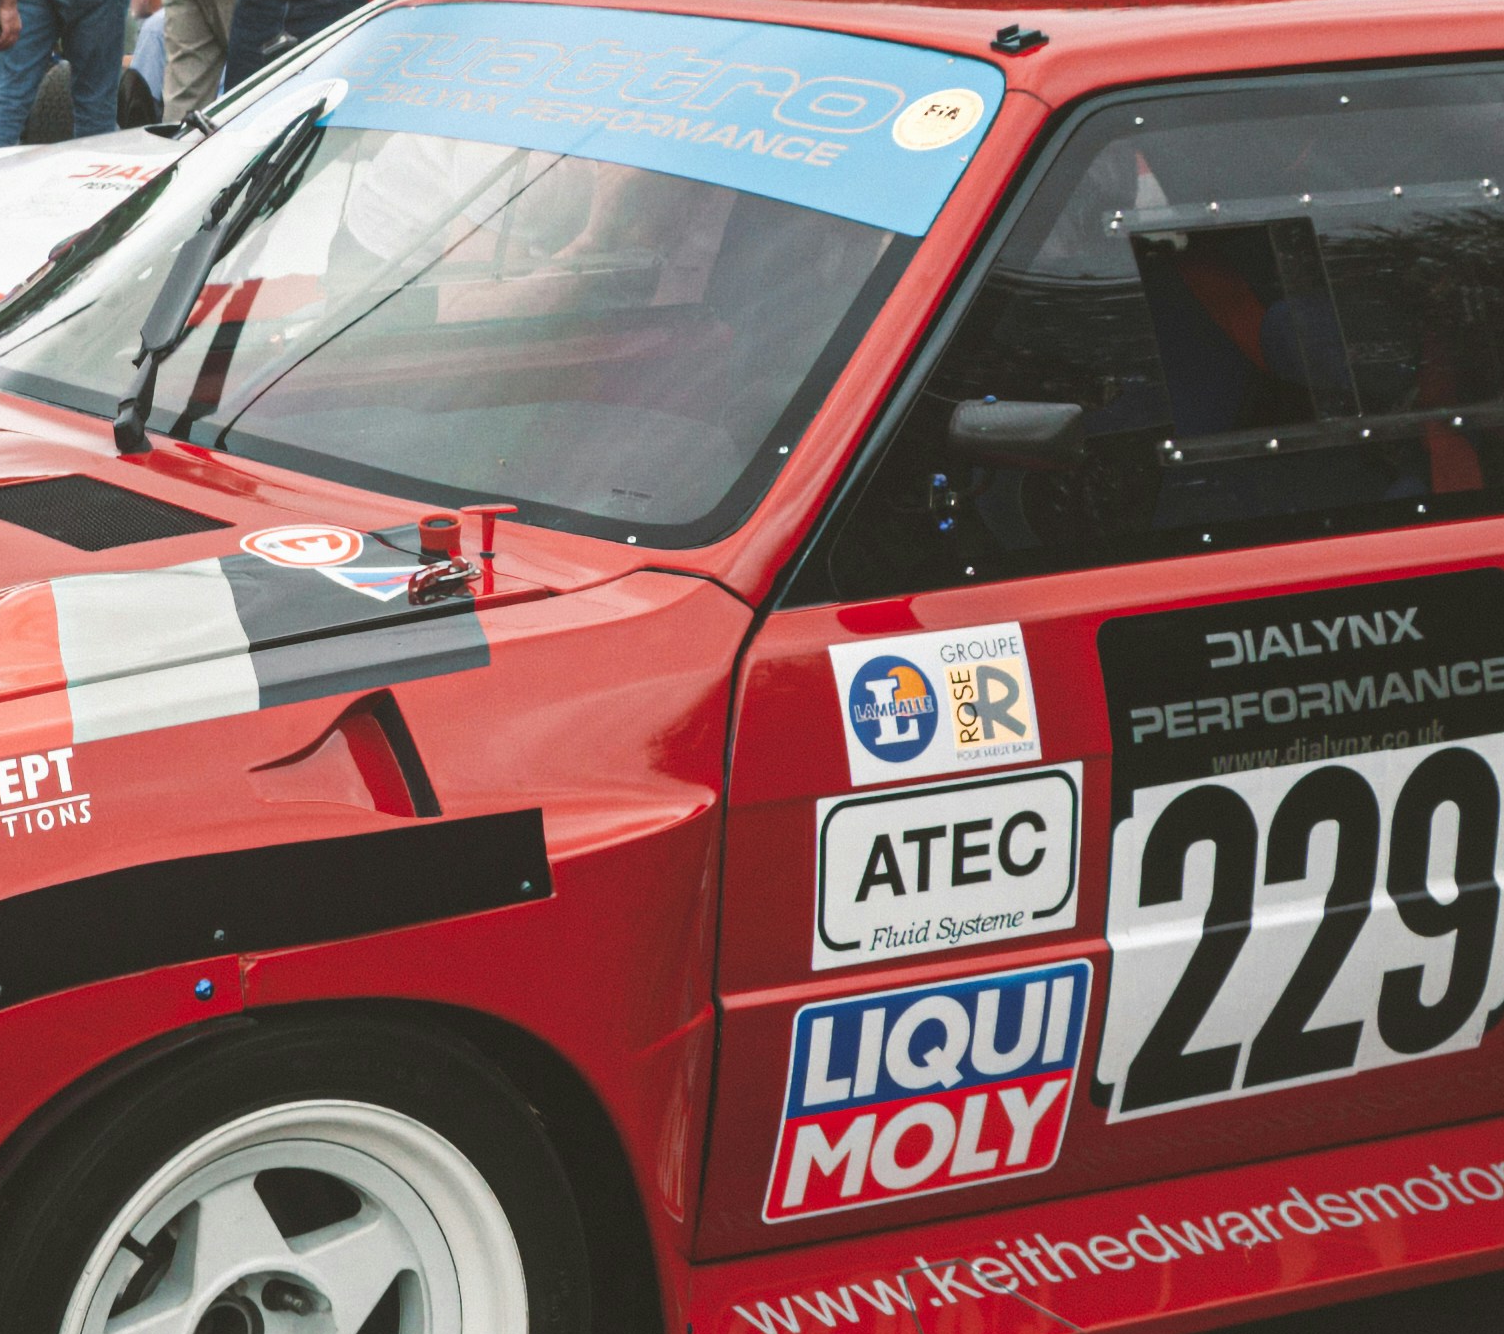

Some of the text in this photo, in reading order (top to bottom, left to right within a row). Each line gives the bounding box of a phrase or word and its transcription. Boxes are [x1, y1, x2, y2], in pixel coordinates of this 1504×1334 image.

[512, 97, 849, 168] PERFORMANCE
[940, 636, 1020, 663] GROUPE
[1205, 606, 1424, 668] DIALYNX
[853, 694, 935, 723] LAMBALLE
[950, 668, 981, 744] ROSE
[1211, 718, 1446, 775] www.dialynx.couk
[854, 810, 1047, 903] ATEC
[868, 910, 1025, 952] Fluid Systeme
[1119, 746, 1501, 1114] 229
[802, 975, 1075, 1108] LIQUI
[781, 1077, 1069, 1209] MOLY
